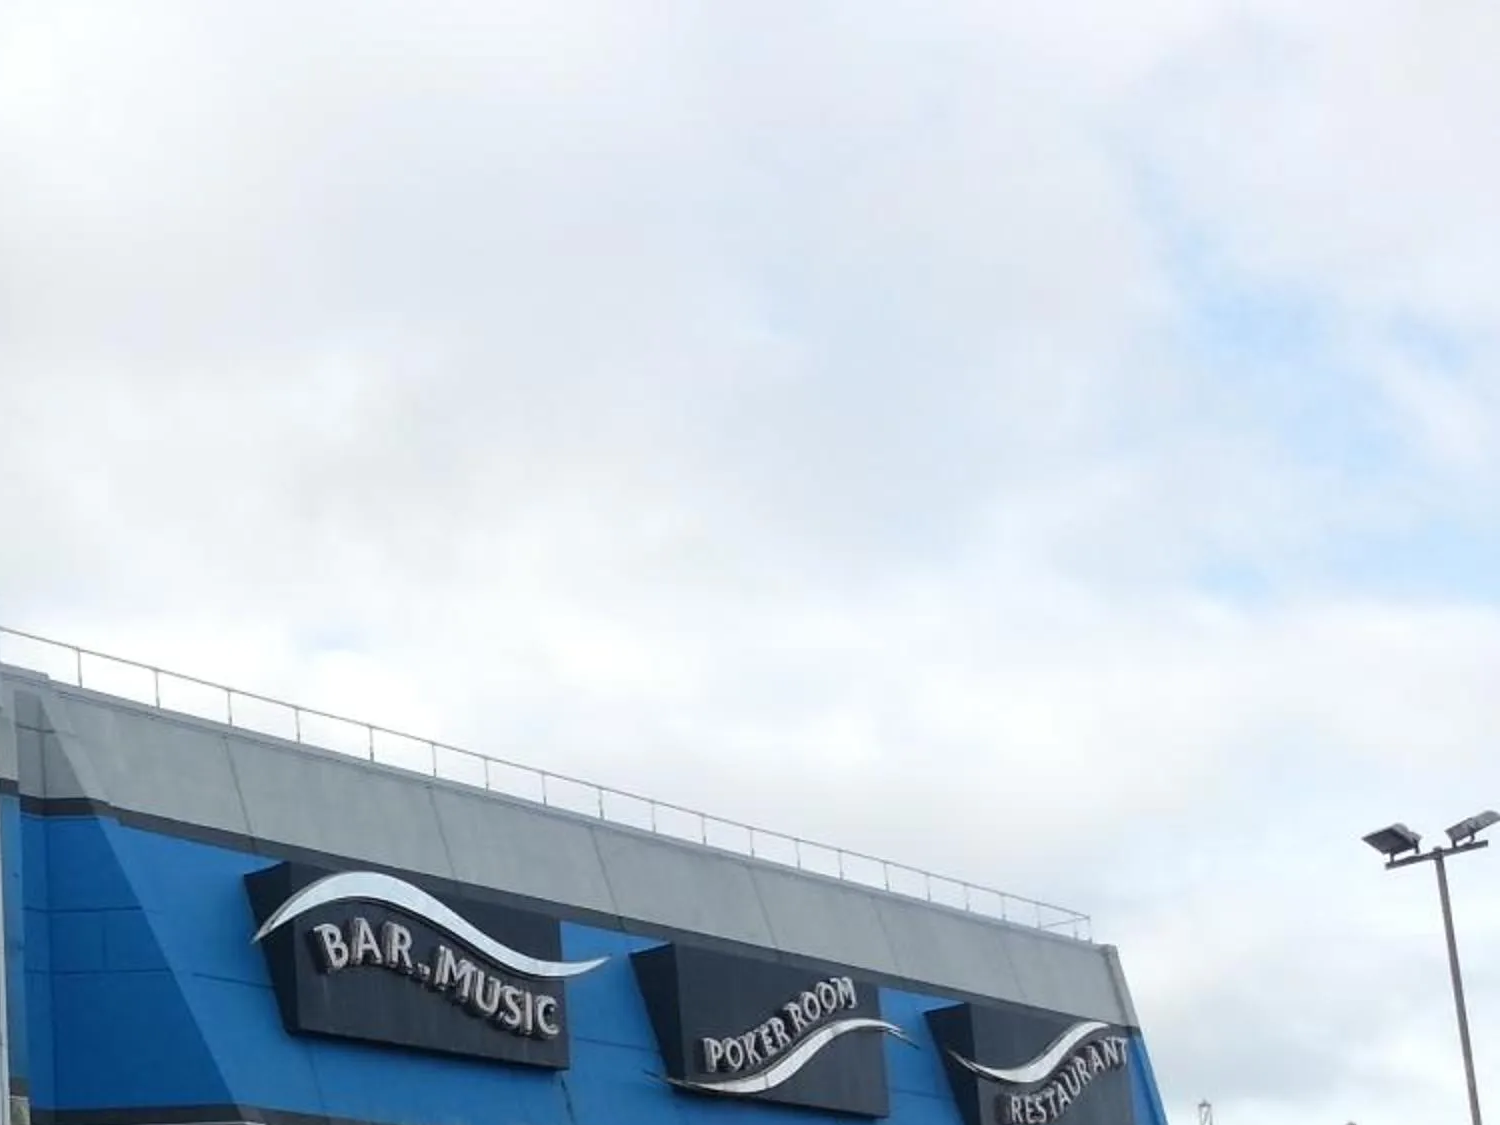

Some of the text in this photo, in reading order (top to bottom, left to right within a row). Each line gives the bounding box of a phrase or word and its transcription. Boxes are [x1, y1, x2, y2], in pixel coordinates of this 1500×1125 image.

[434, 944, 560, 1039] MUSIC
[702, 975, 858, 1073] POKER ROOM
[1008, 1035, 1129, 1125] RESTAURANT
